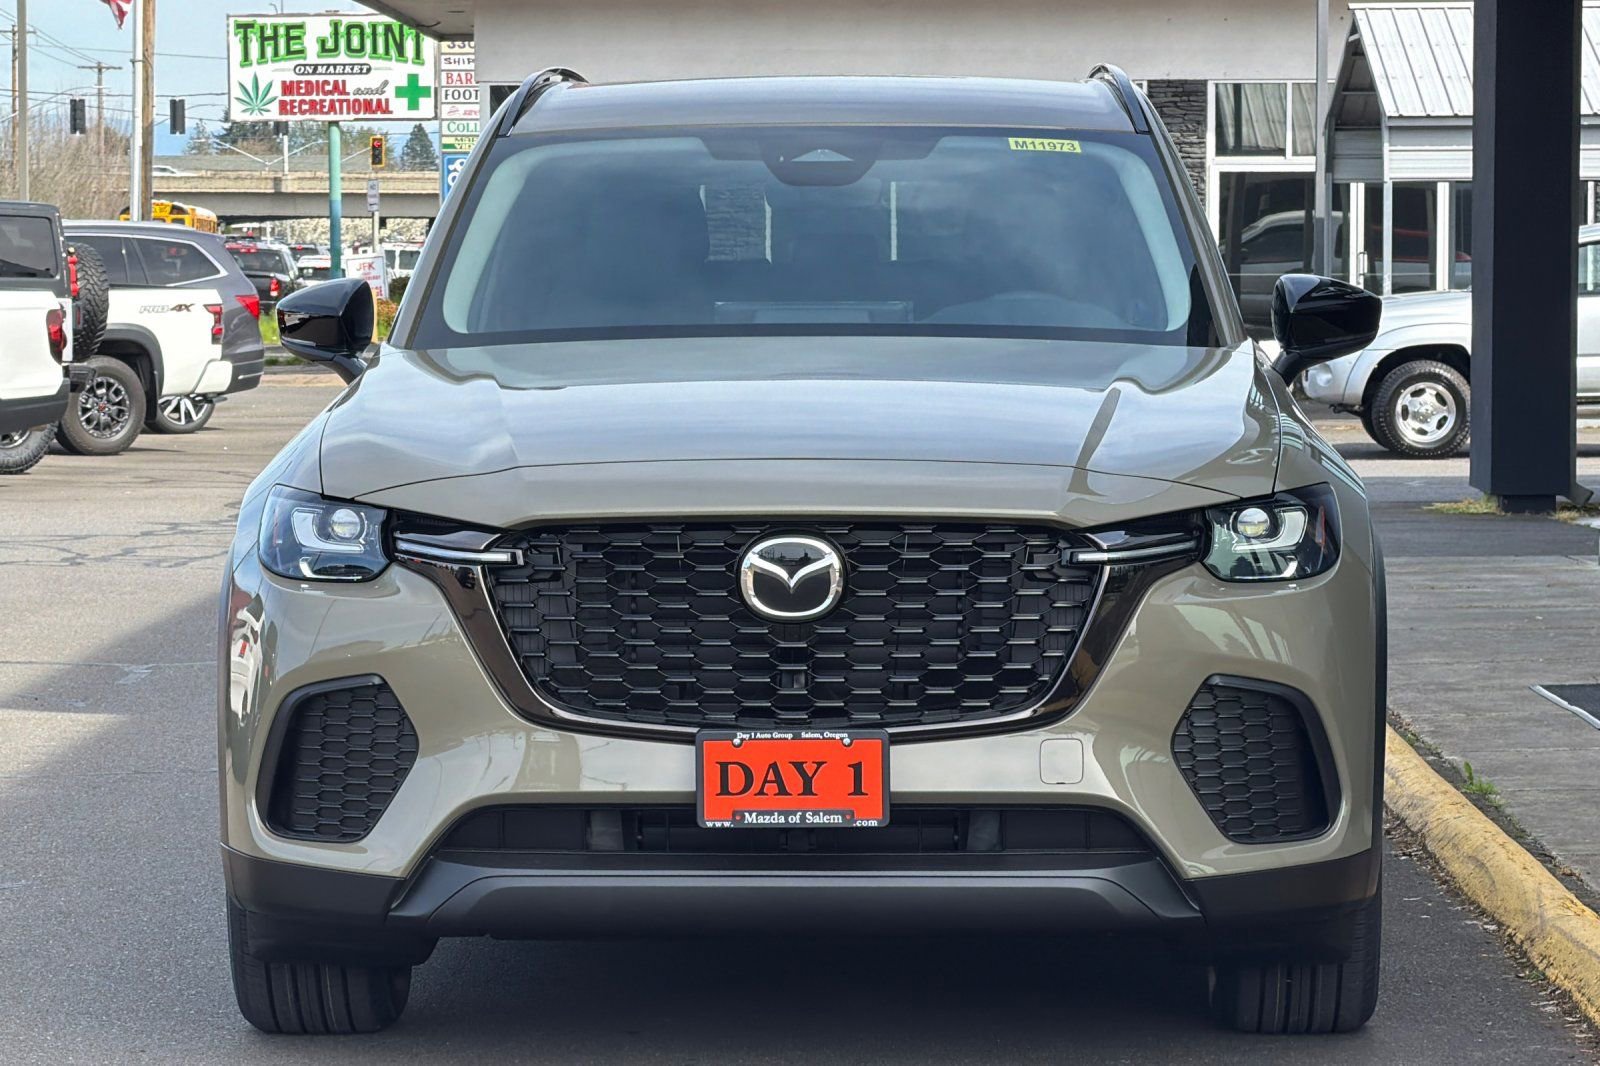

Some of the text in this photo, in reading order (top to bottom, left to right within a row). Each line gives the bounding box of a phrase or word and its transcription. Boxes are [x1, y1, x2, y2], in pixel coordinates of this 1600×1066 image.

[234, 19, 425, 67] THE JOINT
[295, 64, 370, 74] ON MARKET
[281, 79, 390, 97] MEDICAL and
[278, 98, 394, 116] RECREATIONAL
[1014, 140, 1077, 152] M11973
[356, 262, 376, 271] JFK
[736, 732, 750, 740] Day
[772, 731, 793, 740] Group
[801, 731, 823, 740] Salem,
[823, 731, 848, 740] Oregon
[715, 761, 869, 797] DAY 1
[744, 812, 843, 824] Mazda of Salem
[852, 819, 878, 827] .com
